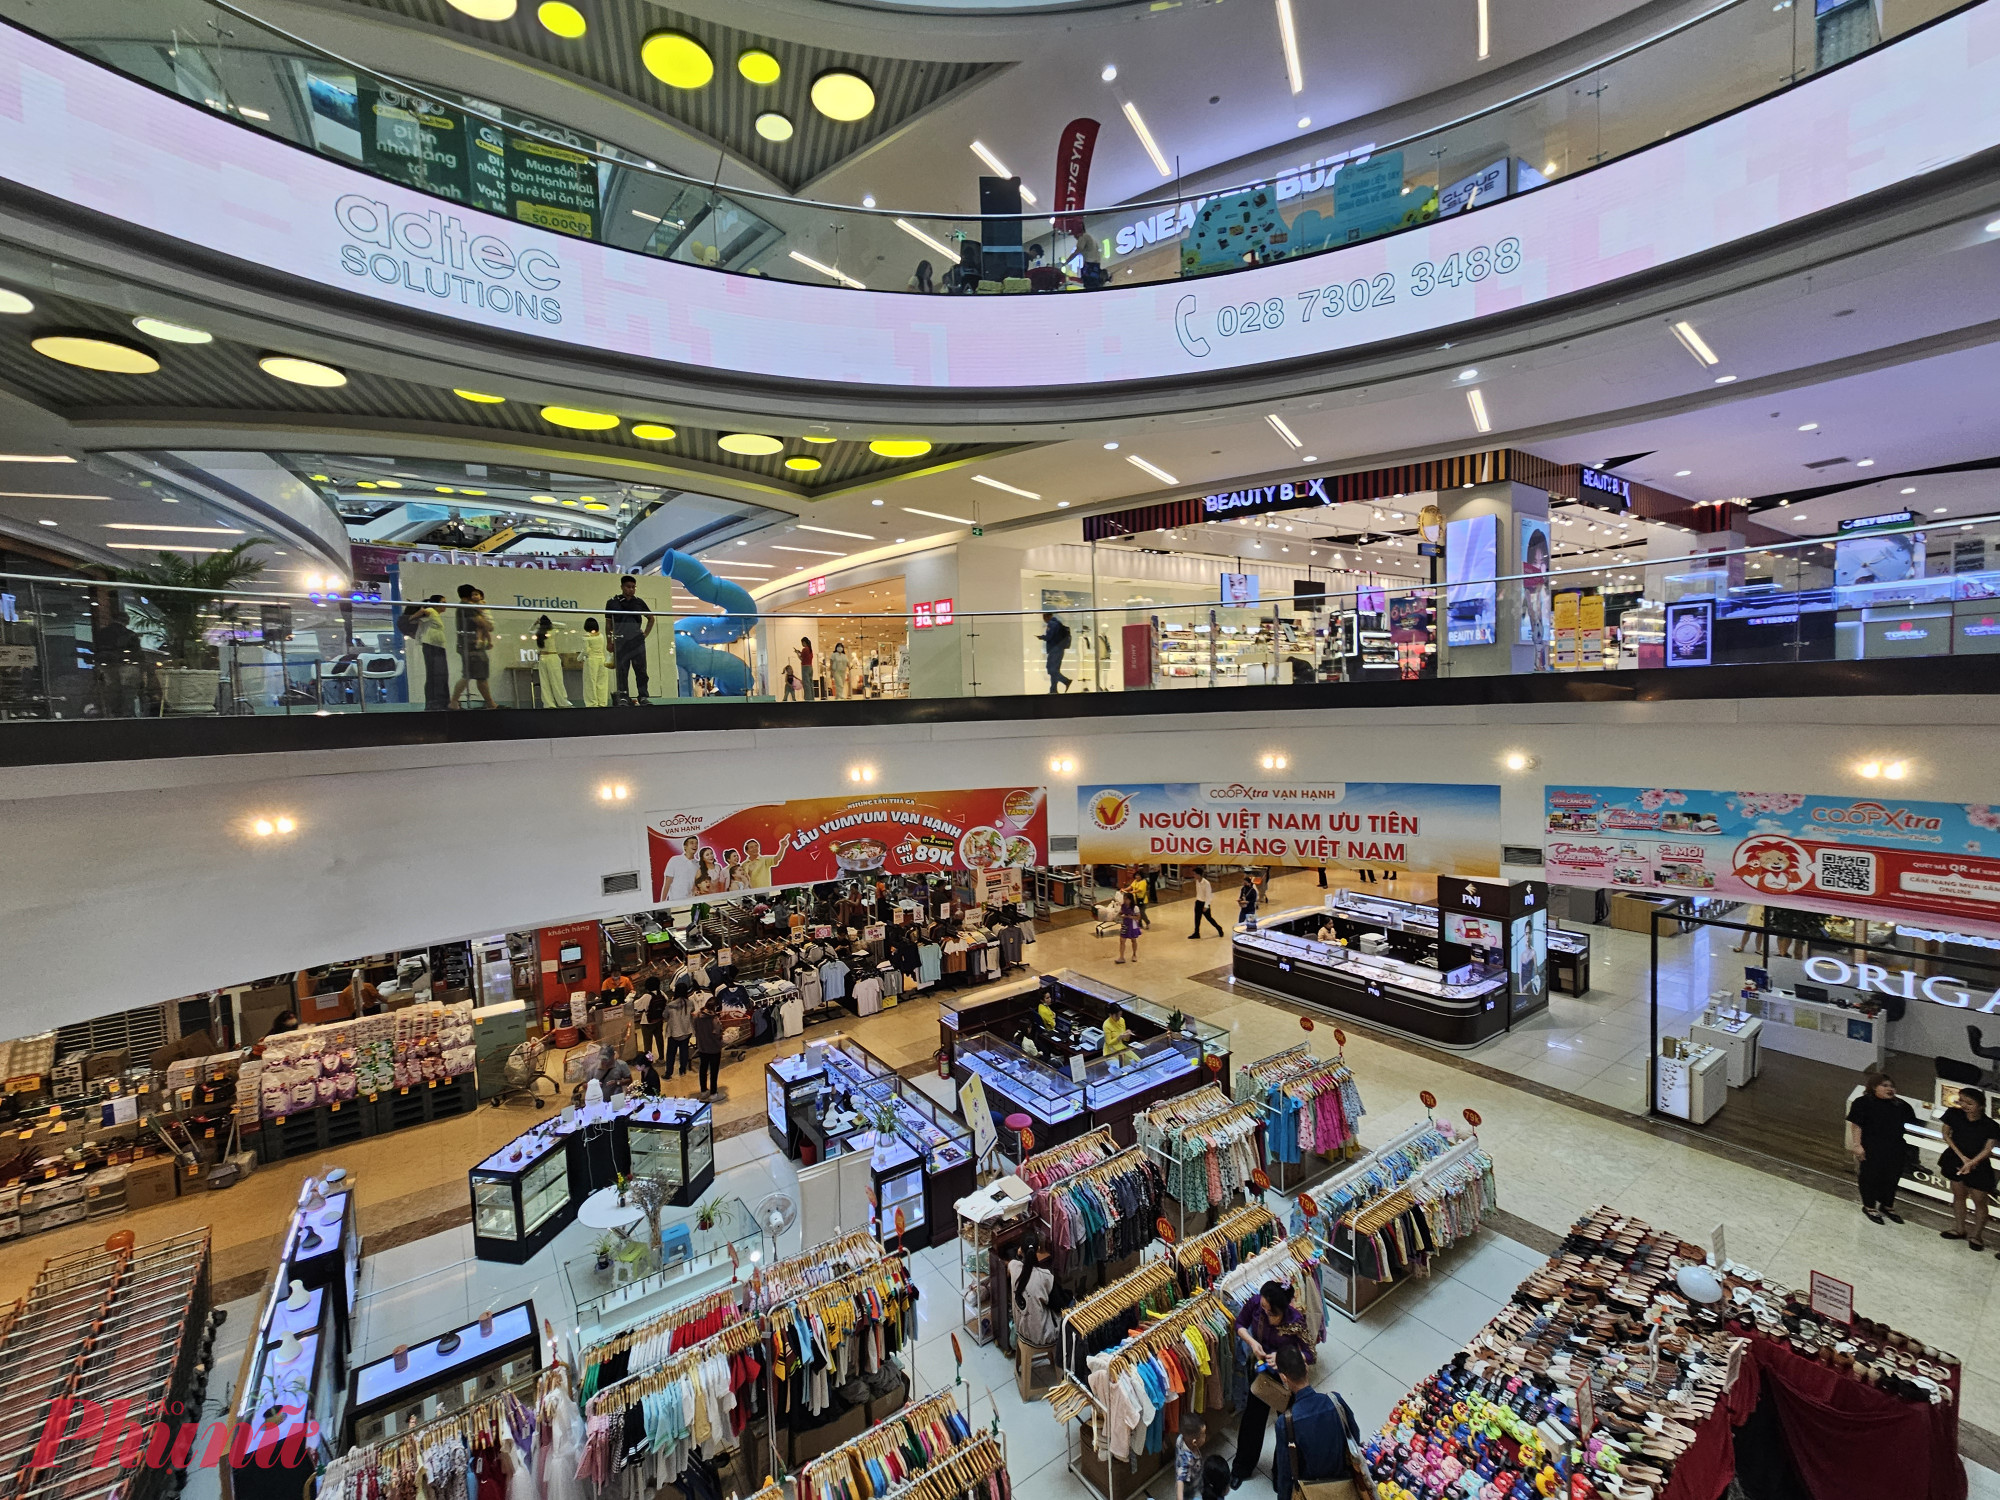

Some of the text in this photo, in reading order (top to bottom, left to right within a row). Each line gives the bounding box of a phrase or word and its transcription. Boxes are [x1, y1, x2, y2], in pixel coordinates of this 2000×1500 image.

[526, 158, 552, 173] Mua
[511, 168, 594, 195] Vạn Hạnh Mall
[511, 182, 524, 193] Đi
[1442, 170, 1500, 203] CLOUD
[1446, 182, 1495, 209] SLDE
[335, 194, 560, 291] adtec
[340, 244, 562, 324] SOLUTIONS
[1217, 236, 1522, 337] 028 7302 3488
[513, 594, 578, 609] Torriden
[1273, 789, 1297, 800] VẠN
[1302, 790, 1335, 801] HẠNH
[819, 810, 888, 835] YUMYUM
[890, 810, 921, 825] VẠN
[922, 815, 963, 839] HẠNH
[1139, 808, 1418, 835] NGƯỜI VIỆT NAM ƯU TIÊN
[914, 845, 955, 866] 89K
[1150, 831, 1405, 862] DÙNG HÀNG VIỆT NAM
[1949, 863, 1968, 873] QR
[1462, 894, 1481, 908] PNJ
[1939, 886, 1972, 895] ONLINE
[1300, 1196, 1316, 1213] 79K
[1203, 1251, 1218, 1271] 99K
